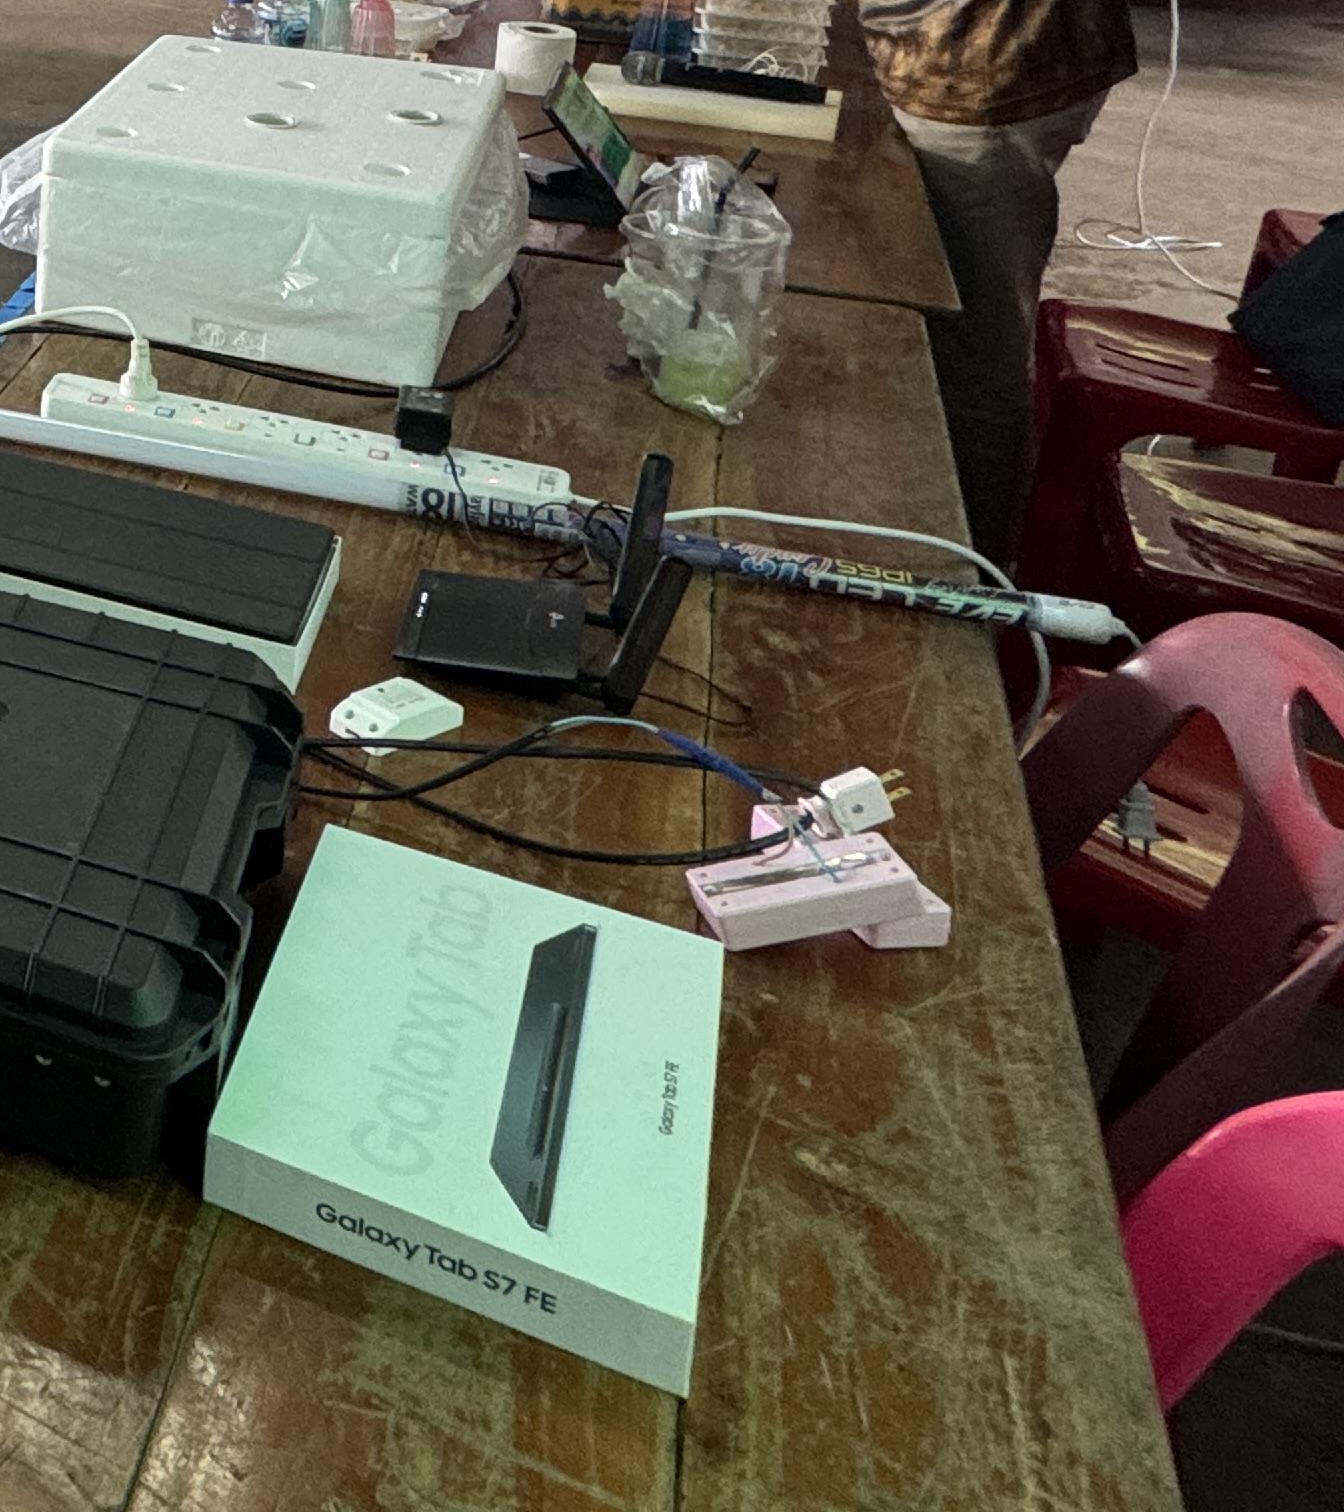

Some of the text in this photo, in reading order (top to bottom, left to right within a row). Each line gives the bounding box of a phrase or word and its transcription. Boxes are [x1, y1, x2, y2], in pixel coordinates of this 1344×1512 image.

[349, 884, 495, 1177] Galaxy Tab
[315, 1201, 559, 1316] Galaxy Tab S7 FE
